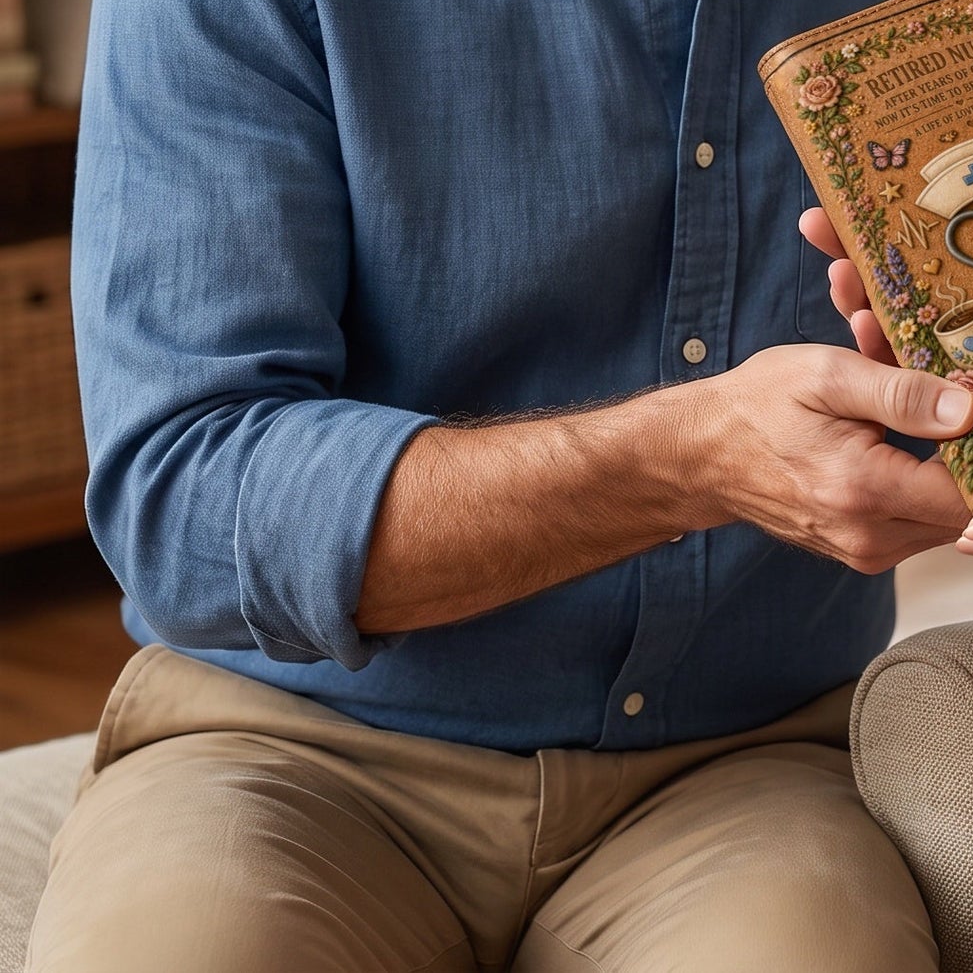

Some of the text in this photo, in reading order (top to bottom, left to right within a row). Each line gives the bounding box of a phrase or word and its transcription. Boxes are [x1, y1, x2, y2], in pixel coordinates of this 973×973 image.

[865, 52, 946, 99] RETIRED
[885, 88, 918, 109] AFTER
[917, 74, 954, 94] YEARS
[954, 68, 968, 80] OF
[875, 112, 898, 128] NOW
[900, 105, 920, 118] IT'S
[920, 92, 947, 108] TIME
[947, 86, 962, 98] TO
[914, 128, 922, 137] A
[921, 118, 943, 133] LIFE
[942, 113, 954, 124] OF
